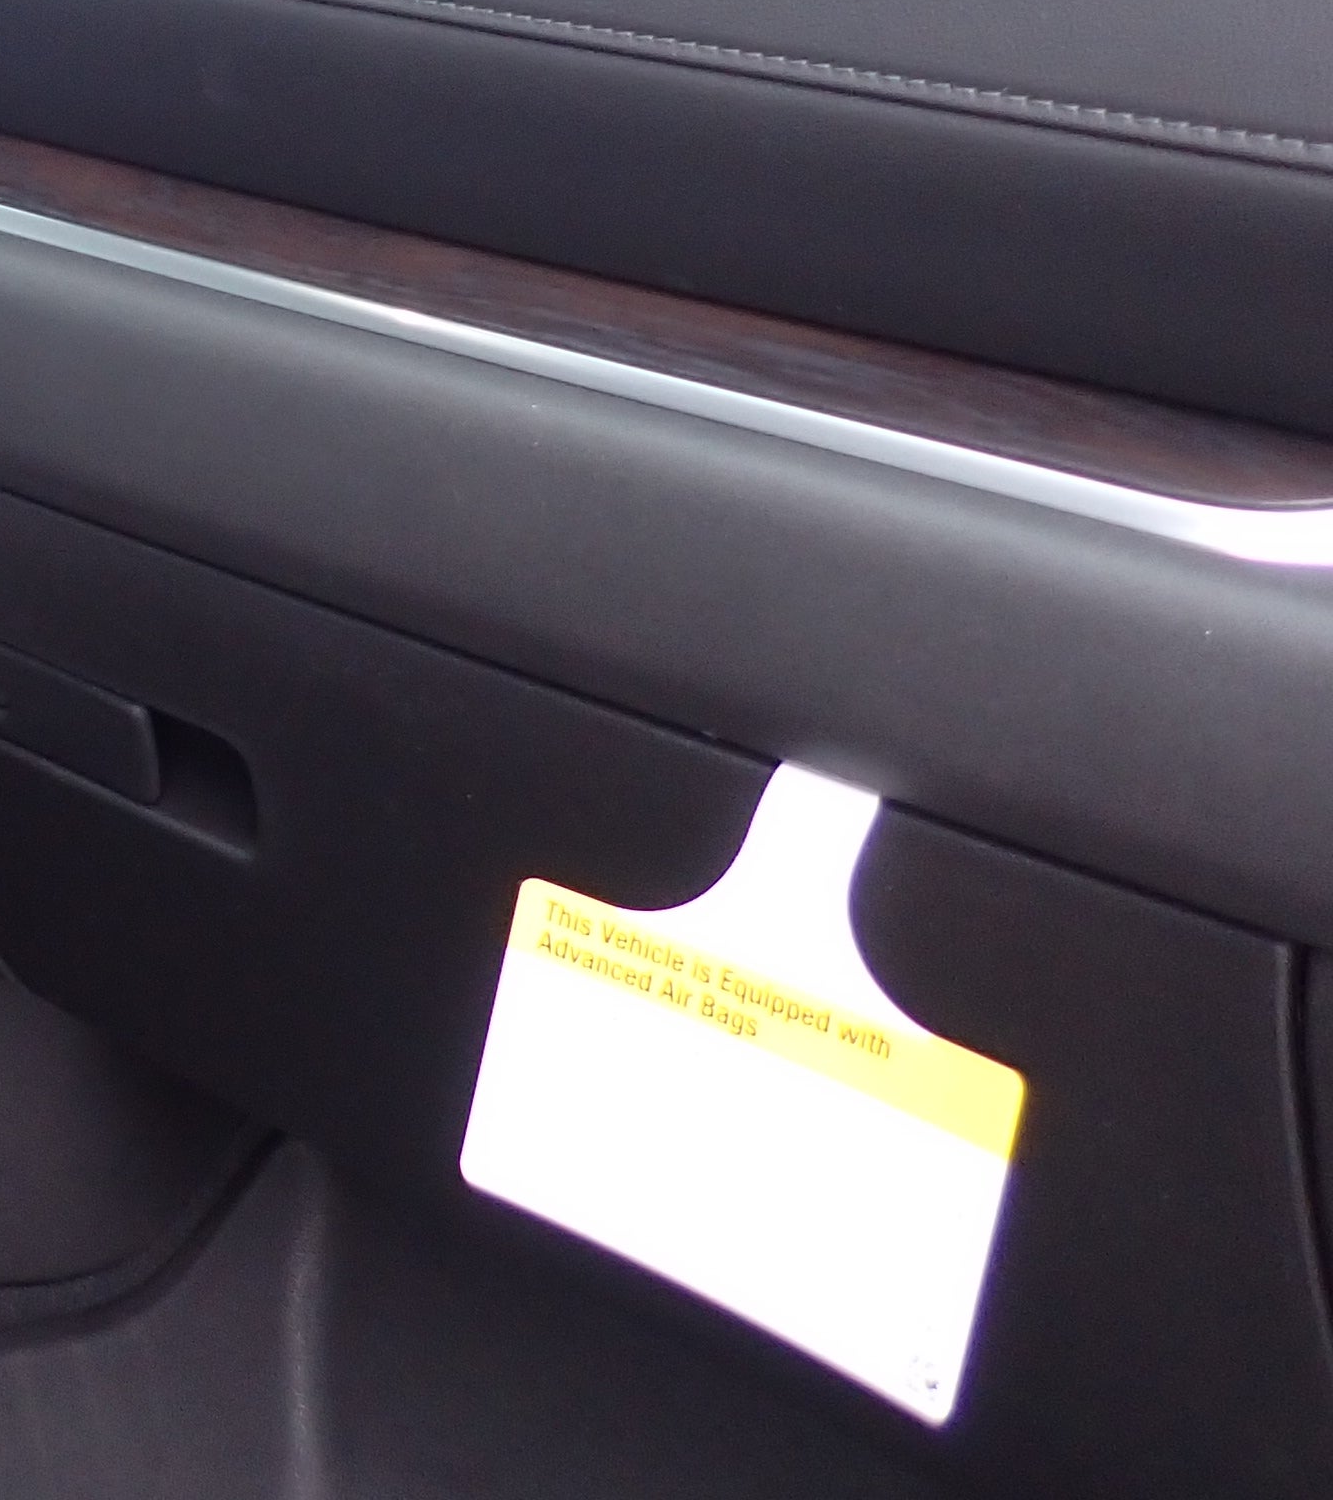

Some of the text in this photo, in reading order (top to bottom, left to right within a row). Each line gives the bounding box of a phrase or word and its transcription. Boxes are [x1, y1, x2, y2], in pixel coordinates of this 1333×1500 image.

[538, 930, 758, 1037] Advanced Air Bags
[546, 899, 892, 1060] This Vehicle is Equipped with
